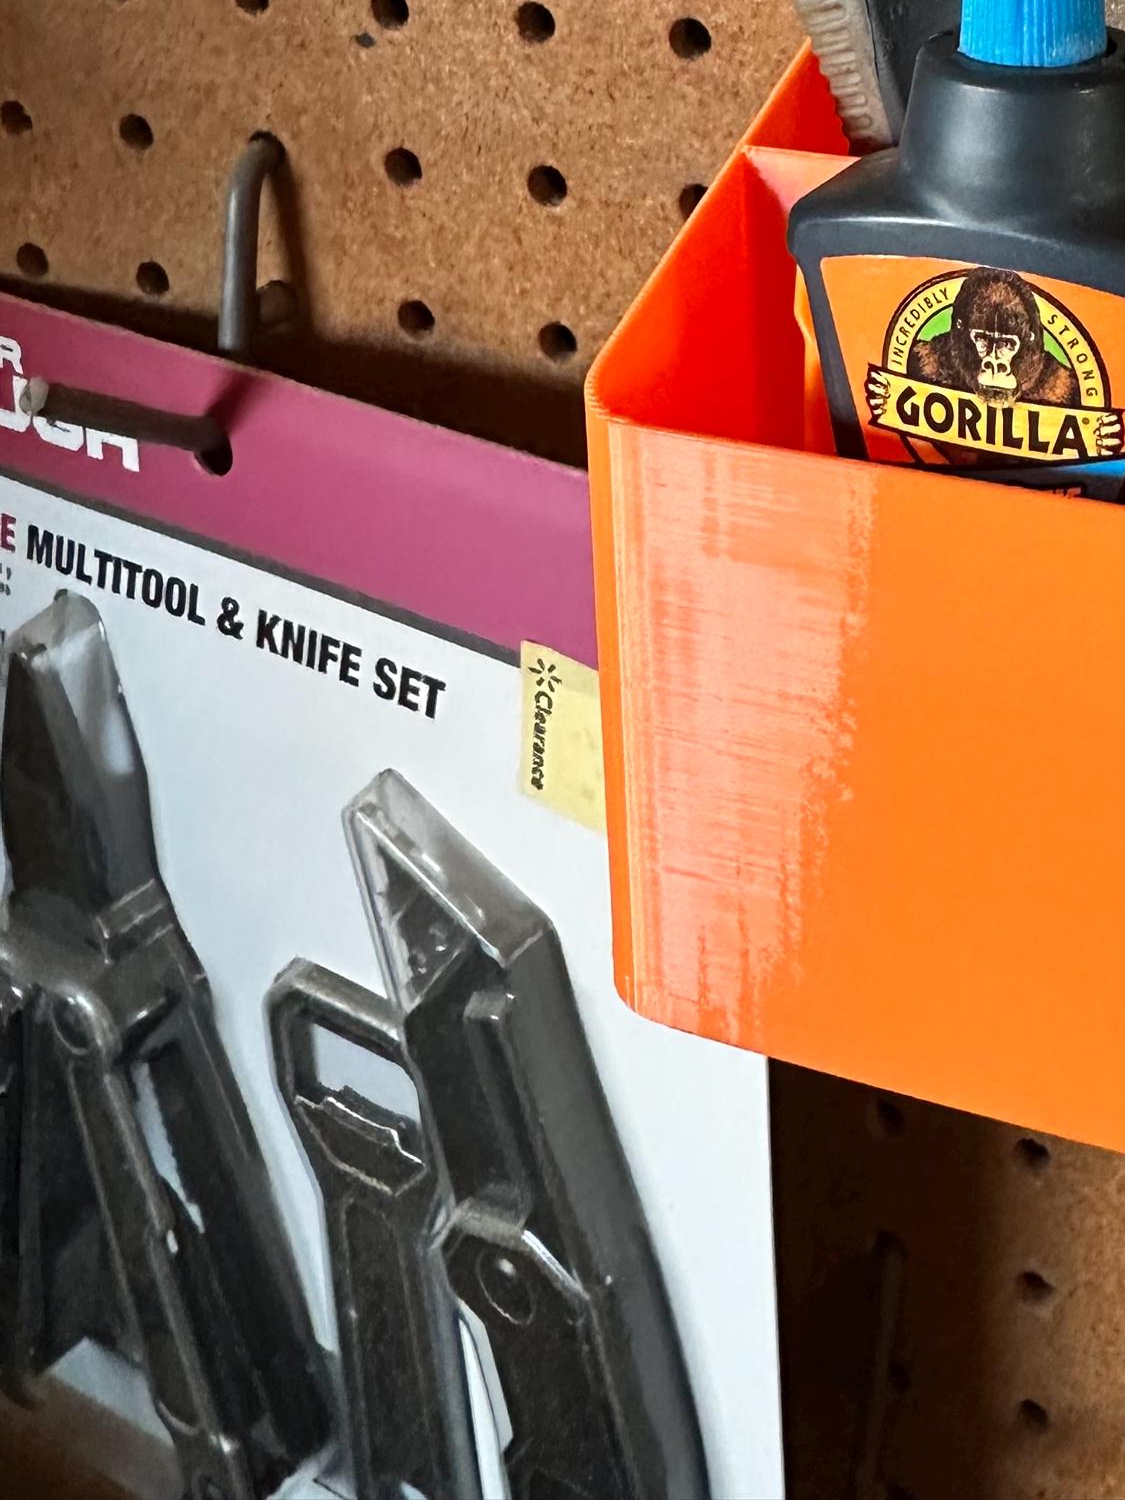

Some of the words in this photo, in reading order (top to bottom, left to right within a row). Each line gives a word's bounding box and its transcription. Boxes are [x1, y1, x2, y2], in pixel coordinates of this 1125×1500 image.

[891, 286, 949, 366] INCREDIBLY
[1046, 313, 1098, 397] STRONG
[895, 385, 1088, 460] GORILLA
[26, 524, 206, 627] MULTITOOL
[216, 596, 243, 640] &
[256, 609, 362, 688] KNIFE
[372, 657, 447, 720] SET
[530, 690, 553, 791] Clearance
